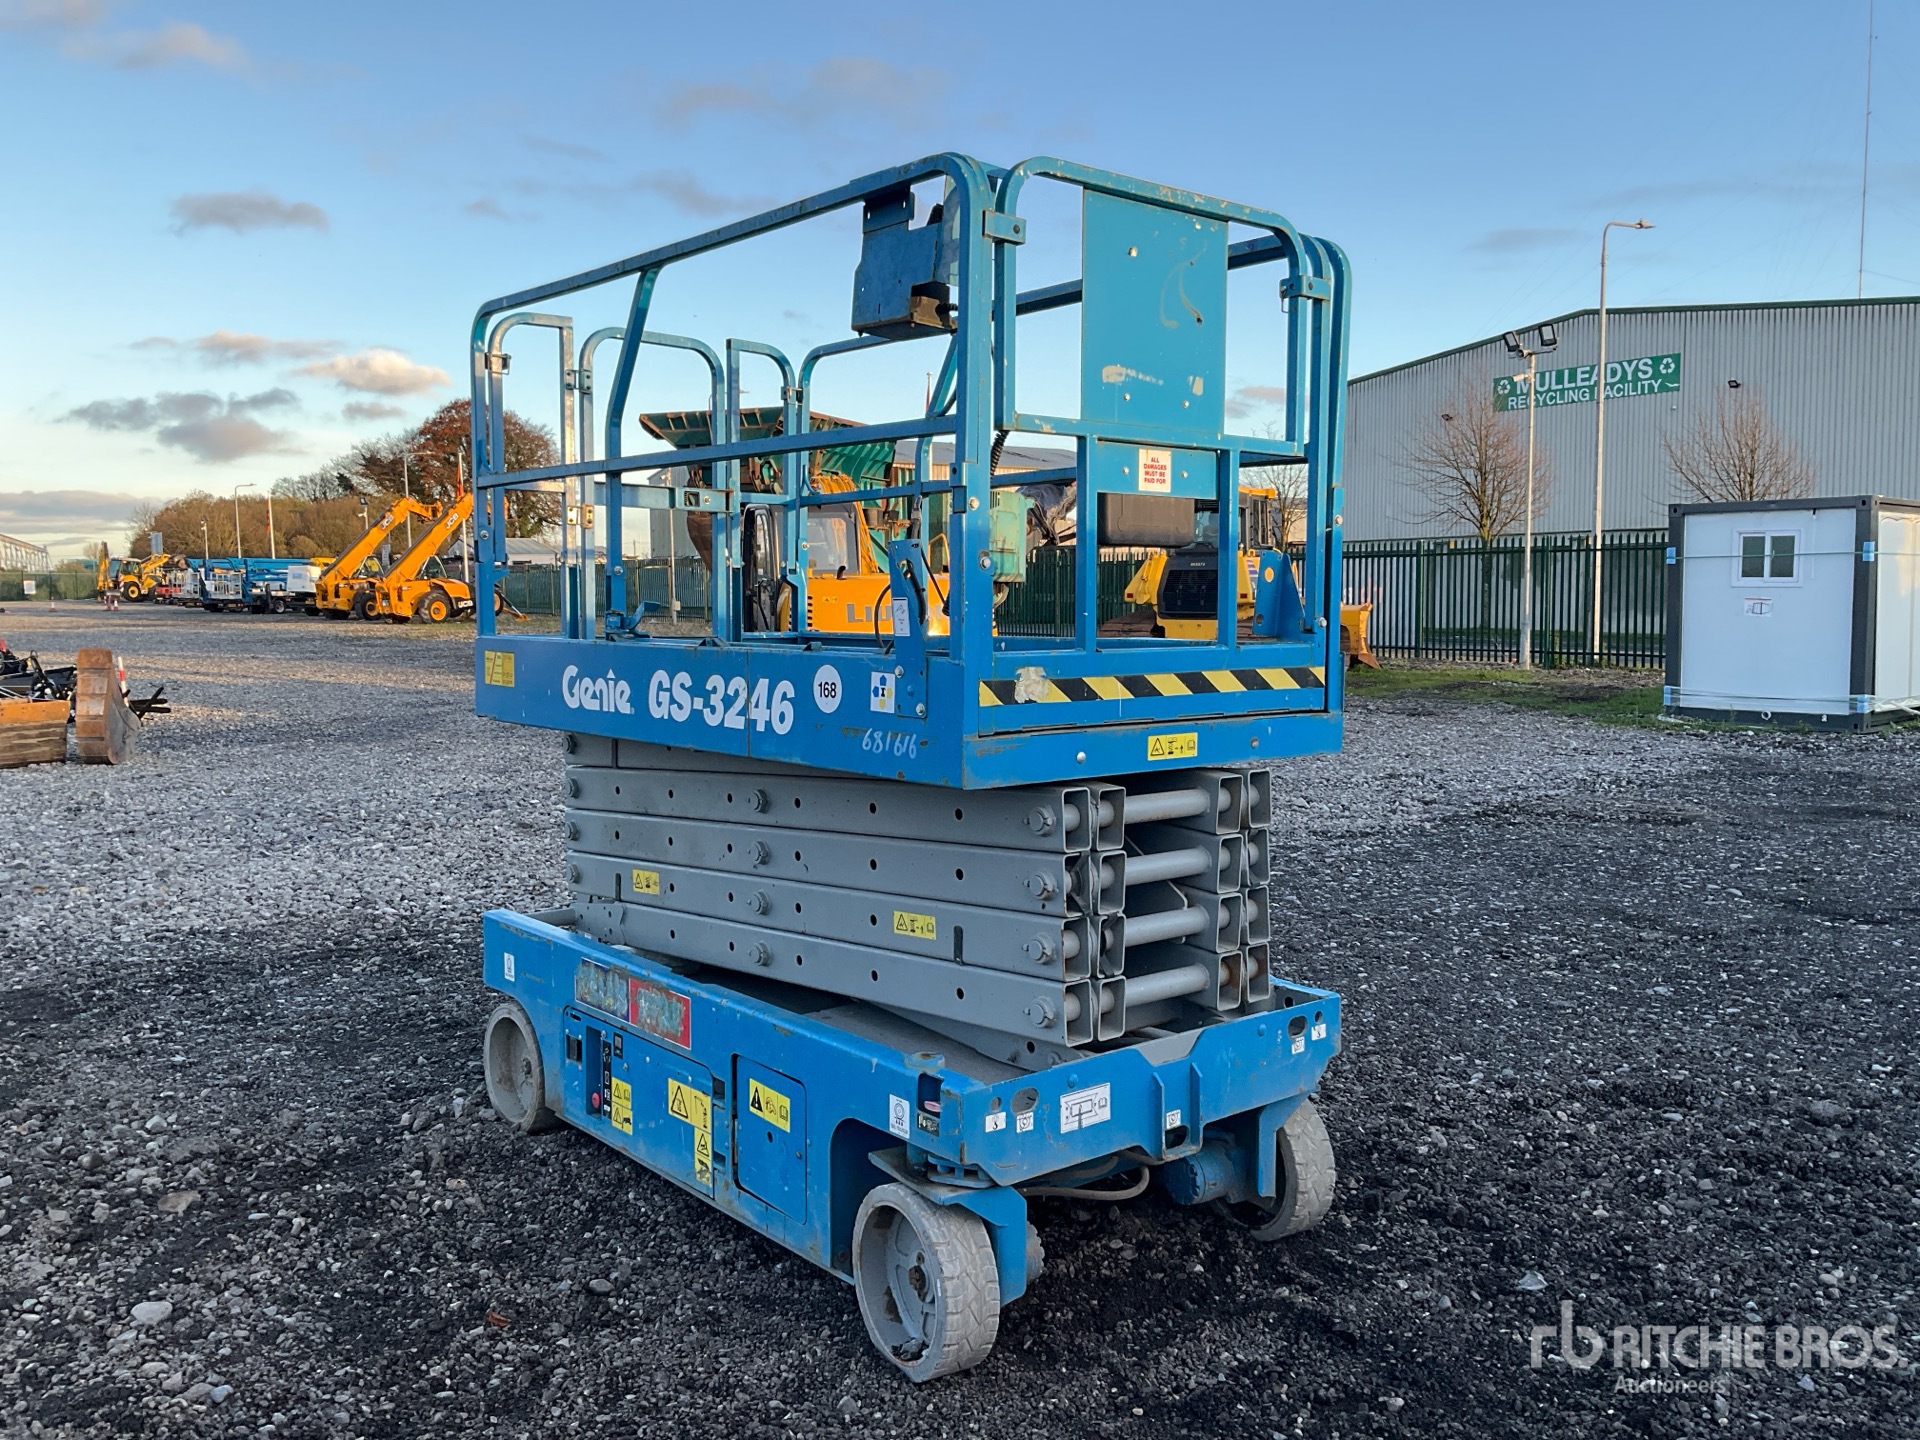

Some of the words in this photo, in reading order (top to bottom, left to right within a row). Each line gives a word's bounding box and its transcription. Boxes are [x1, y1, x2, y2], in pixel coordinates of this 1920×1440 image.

[446, 512, 459, 529] JCB
[458, 600, 474, 608] JCB
[817, 681, 837, 699] 168
[562, 664, 632, 715] Genie
[648, 669, 796, 735] GS-3246
[861, 727, 918, 760] 681616
